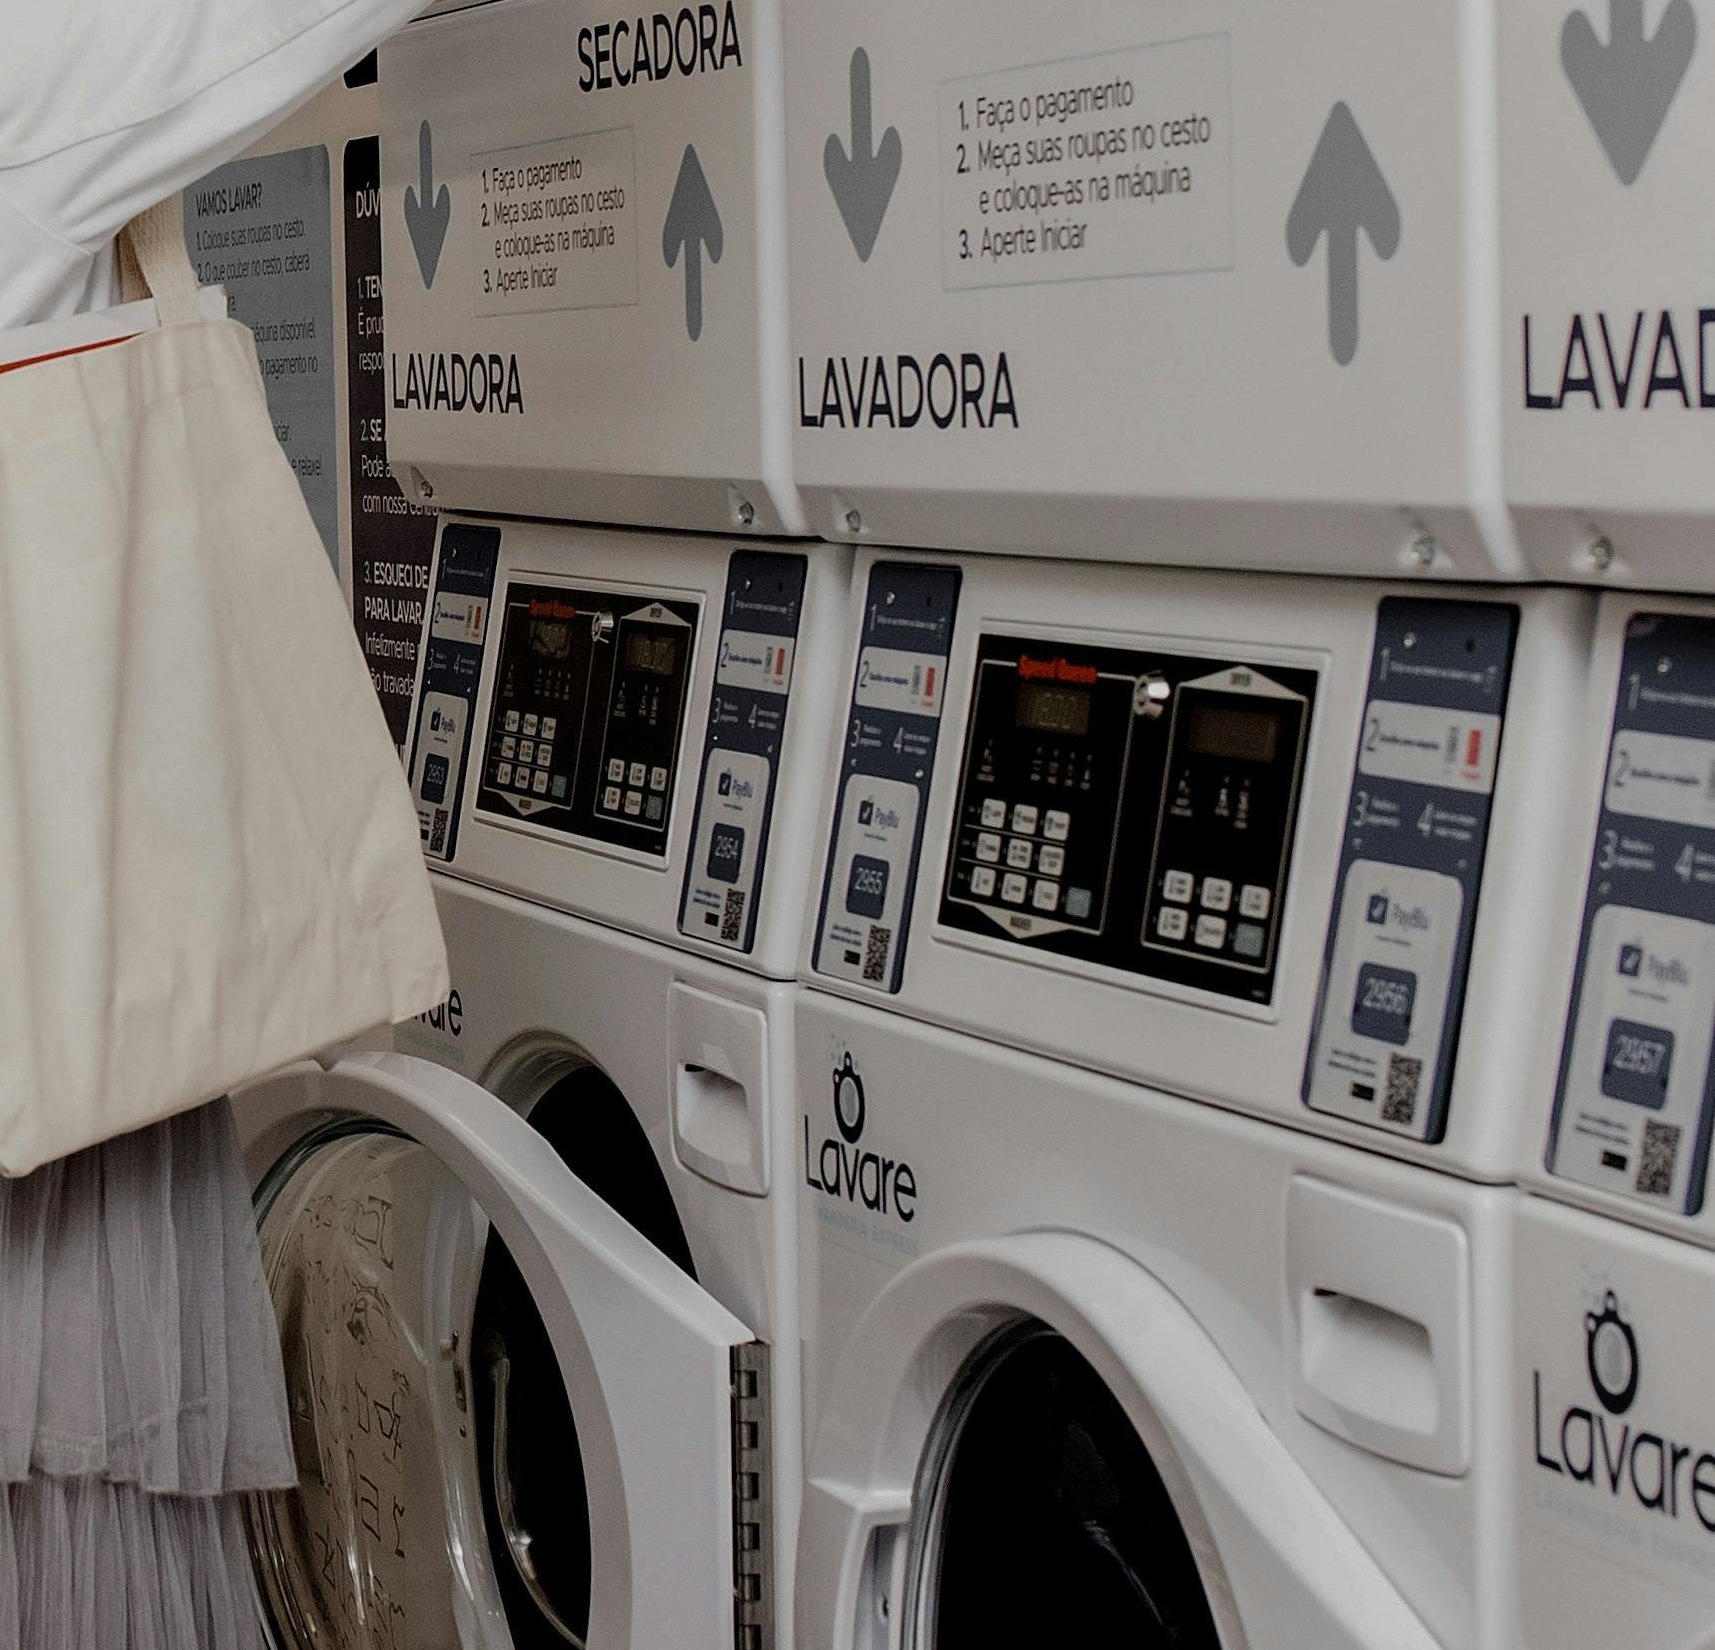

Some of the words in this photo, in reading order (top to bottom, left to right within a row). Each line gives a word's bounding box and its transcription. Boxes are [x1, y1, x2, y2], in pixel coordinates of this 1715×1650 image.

[578, 0, 742, 92] SECADORA
[959, 101, 969, 130] 1.
[977, 97, 1014, 133] Faça
[1020, 97, 1030, 121] o
[1036, 76, 1133, 125] pagamento
[957, 144, 970, 174] 2.
[978, 140, 1020, 175] Meça
[1026, 136, 1062, 165] suas
[1068, 126, 1126, 162] roupas
[1132, 124, 1154, 150] no
[1161, 112, 1210, 148] cesto
[482, 170, 489, 193] 1.
[493, 168, 514, 196] Faça
[517, 169, 524, 188] o
[527, 156, 582, 191] pagamento
[979, 190, 989, 214] e
[994, 180, 1082, 214] coloque-as
[1088, 176, 1108, 201] na
[1115, 161, 1190, 202] máquina
[195, 189, 227, 217] VAMOS
[229, 182, 262, 212] LAVAR?
[482, 202, 490, 227] 2.
[494, 201, 519, 229] Meça
[521, 200, 543, 221] suas
[545, 195, 579, 220] roupas
[581, 193, 594, 213] no
[597, 185, 625, 211] cesto
[495, 240, 501, 258] e
[503, 232, 555, 259] coloque-as
[557, 231, 569, 251] na
[572, 221, 614, 253] máquina
[959, 229, 972, 259] 3.
[981, 224, 1035, 262] Aperte
[1041, 218, 1087, 253] Iniciar
[483, 269, 492, 293] 3.
[496, 267, 528, 296] Aperte
[531, 262, 558, 289] Iniciar
[393, 353, 524, 413] LAVADORA
[798, 352, 1019, 429] LAVADORA
[370, 418, 382, 441] SE
[361, 455, 383, 478] Pode
[363, 495, 381, 513] com
[383, 496, 407, 514] nossa
[374, 562, 412, 588] ESQUECI
[415, 565, 429, 588] DE
[365, 596, 389, 620] PARA
[392, 600, 422, 625] LAVAR
[365, 631, 415, 660] Infelizmente
[805, 1114, 917, 1222] Lavare
[1532, 1369, 1715, 1533] Lavare
